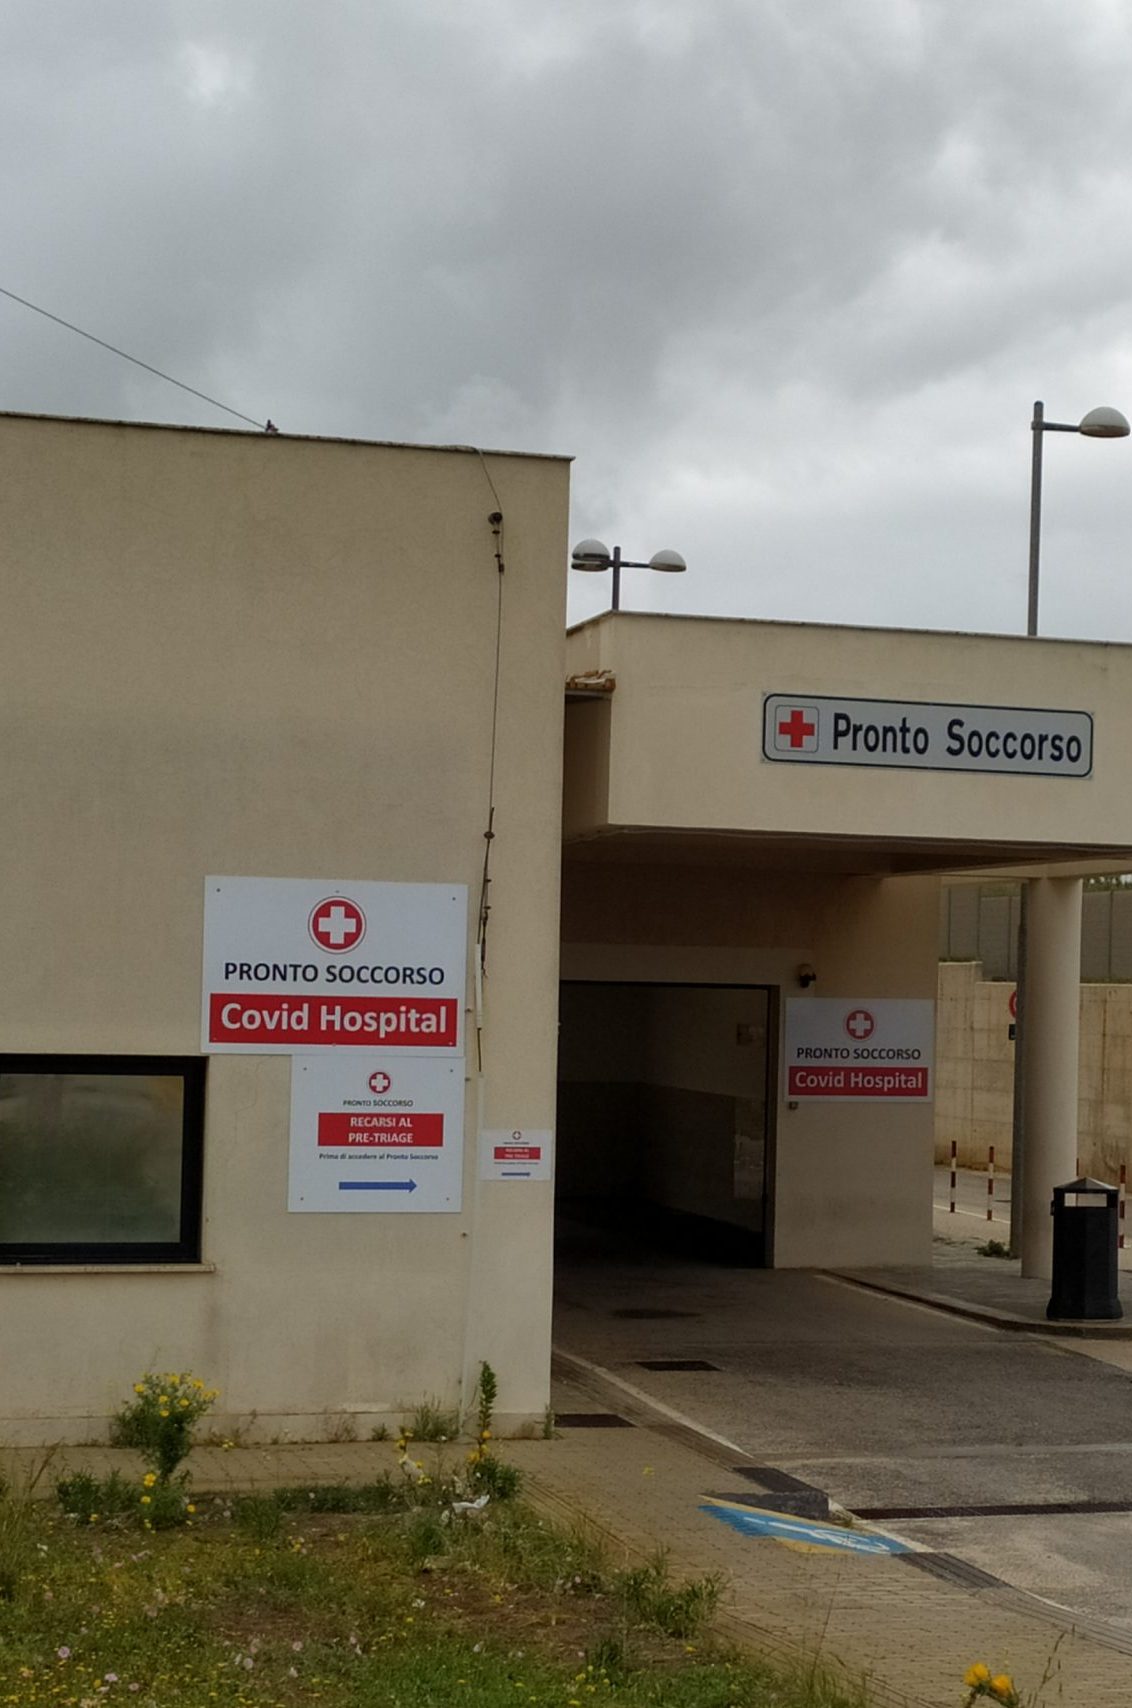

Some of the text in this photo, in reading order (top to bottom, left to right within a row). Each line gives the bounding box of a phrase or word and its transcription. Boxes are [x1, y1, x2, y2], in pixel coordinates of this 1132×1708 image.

[833, 711, 1082, 763] Pronto Soccorso
[224, 962, 445, 986] PRONTO SOCCORSO
[221, 1002, 447, 1039] Covid Hospital
[796, 1047, 922, 1061] PRONTO SOCCORSO
[795, 1071, 922, 1092] Covid Hospital
[342, 1099, 414, 1108] PRONTO SOCCORSO
[350, 1116, 413, 1128] RECARSI AL
[348, 1132, 414, 1144] PRE-TRIAGE
[386, 1152, 408, 1160] Pronto
[409, 1153, 439, 1161] Soccorso
